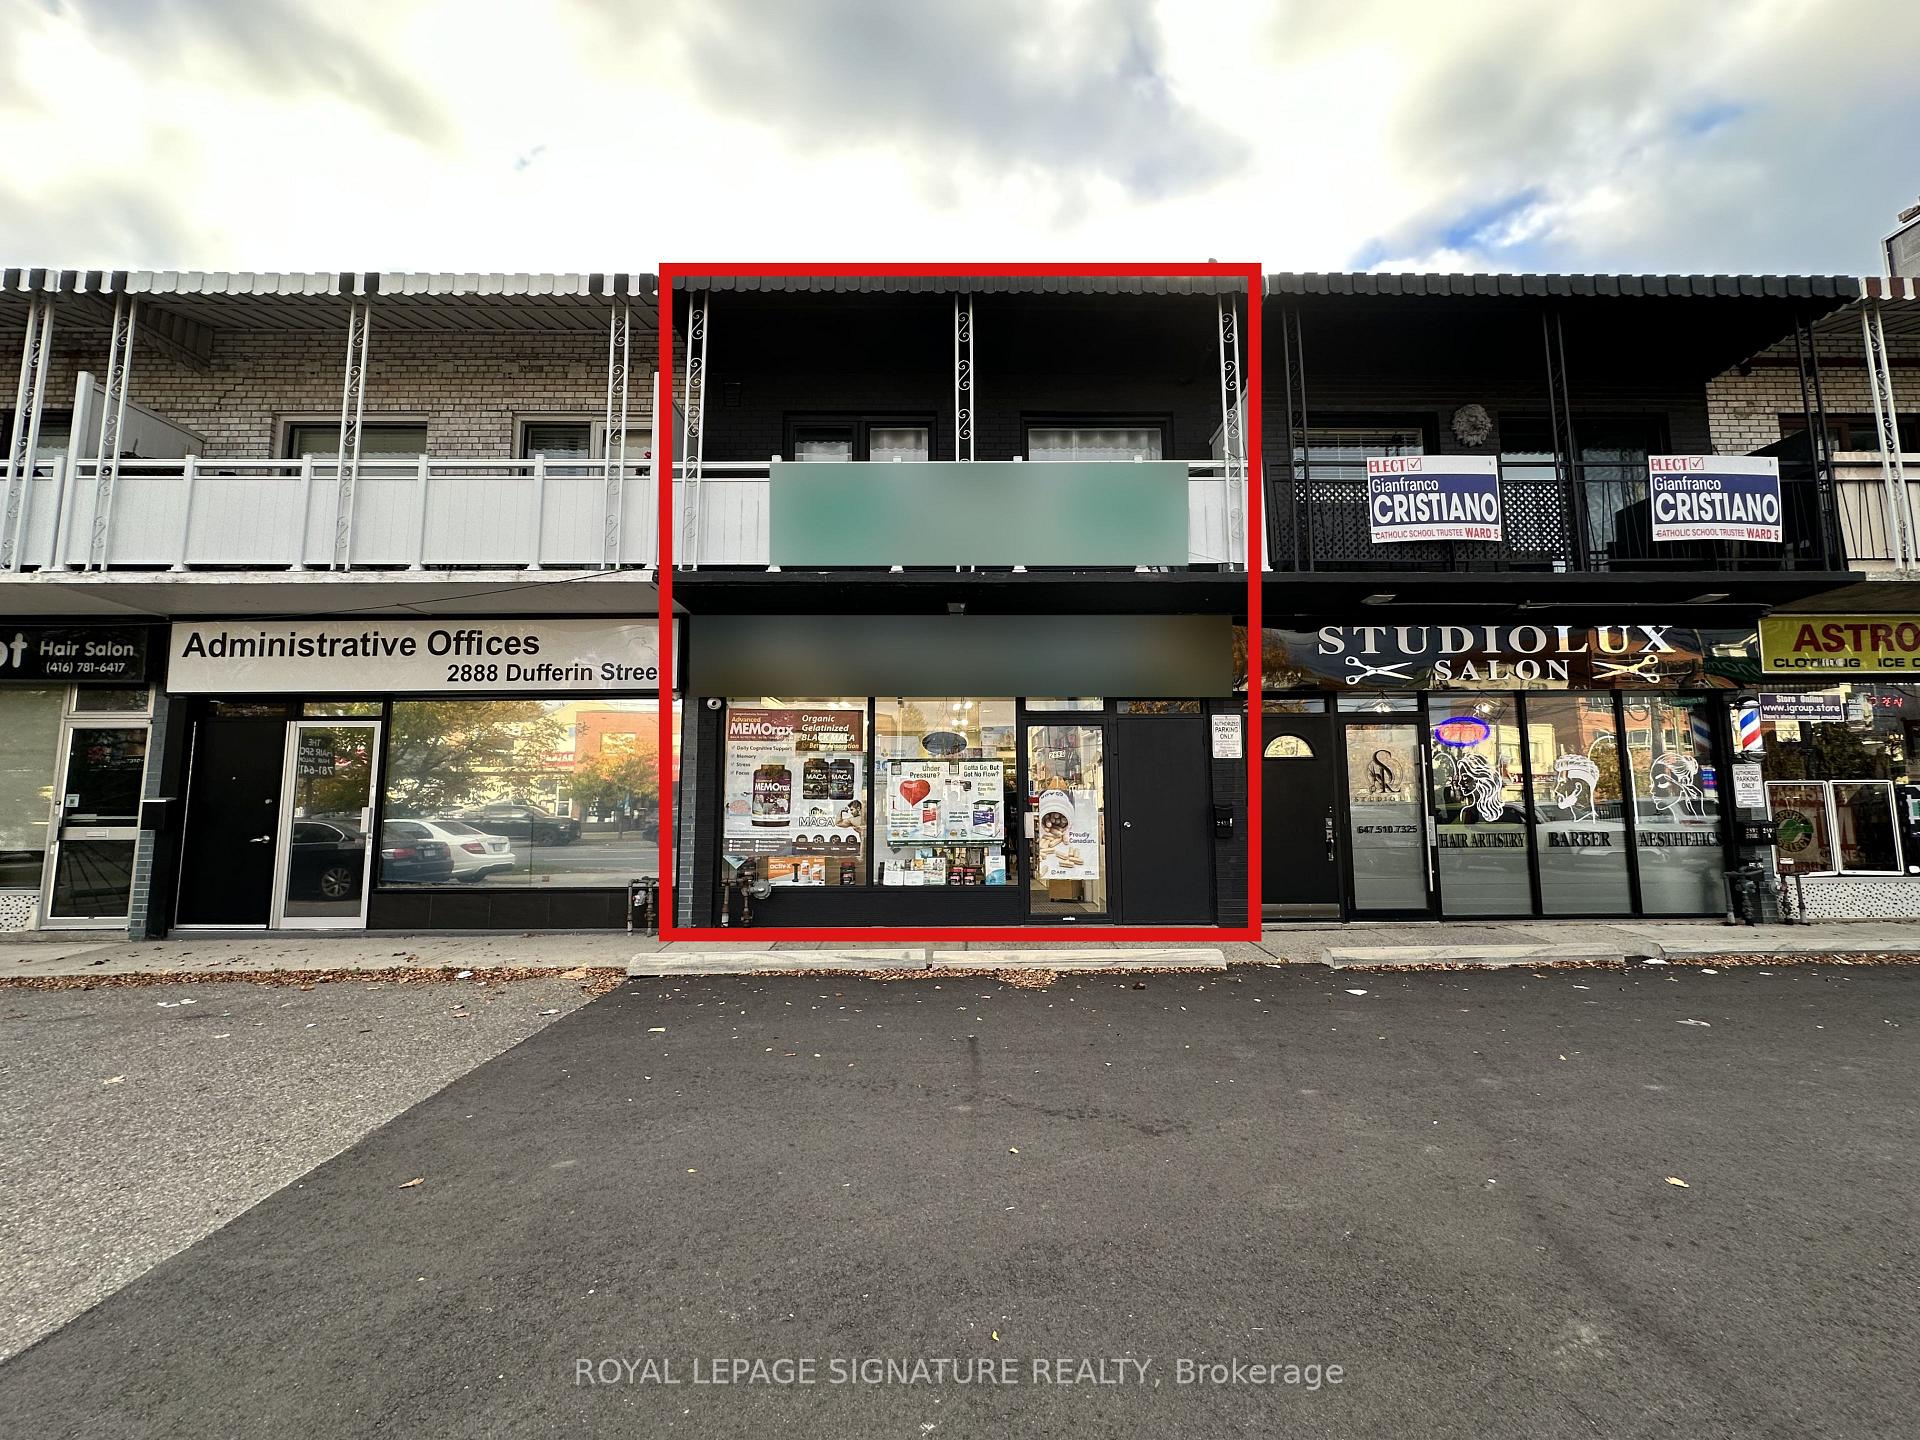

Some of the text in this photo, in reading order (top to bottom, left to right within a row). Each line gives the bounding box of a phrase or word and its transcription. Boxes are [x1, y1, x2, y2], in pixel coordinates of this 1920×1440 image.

[1369, 459, 1406, 473] ELECT
[1651, 458, 1688, 471] ELECT
[1371, 477, 1439, 493] Gianfranco
[1654, 476, 1721, 491] Gianfranco
[1373, 492, 1498, 524] CRISTIANO
[1655, 492, 1779, 523] CRISTIANO
[1375, 527, 1499, 539] CATHOLIC SCHOOL TRUSTEE WARD 5
[1656, 528, 1779, 540] CATHOLIC SCHOOL TRUSTEE WARD 5
[182, 630, 540, 658] Administrative Offices
[1318, 625, 1677, 655] STUDIOLUX
[1793, 623, 1920, 652] ASTRO
[40, 640, 80, 656] Hair
[84, 640, 134, 656] Salon
[46, 662, 125, 673] (416) 781-6417
[1878, 658, 1905, 667] ICE
[447, 663, 658, 682] 2888 Dufferin Stree
[1434, 659, 1570, 681] SALON
[1762, 704, 1841, 714] www.igroup.store
[802, 714, 836, 723] Organic
[730, 722, 794, 736] MEMOrax
[802, 724, 849, 732] Gelatinized
[754, 783, 791, 792] MEMOrax
[798, 817, 835, 827] MACA
[1069, 832, 1090, 840] Proudly
[1357, 825, 1418, 834] 647.510.7325
[1439, 833, 1525, 848] HAIR ARTISTRY
[1549, 832, 1612, 847] BARBER
[1638, 832, 1723, 848] AESTHETICS
